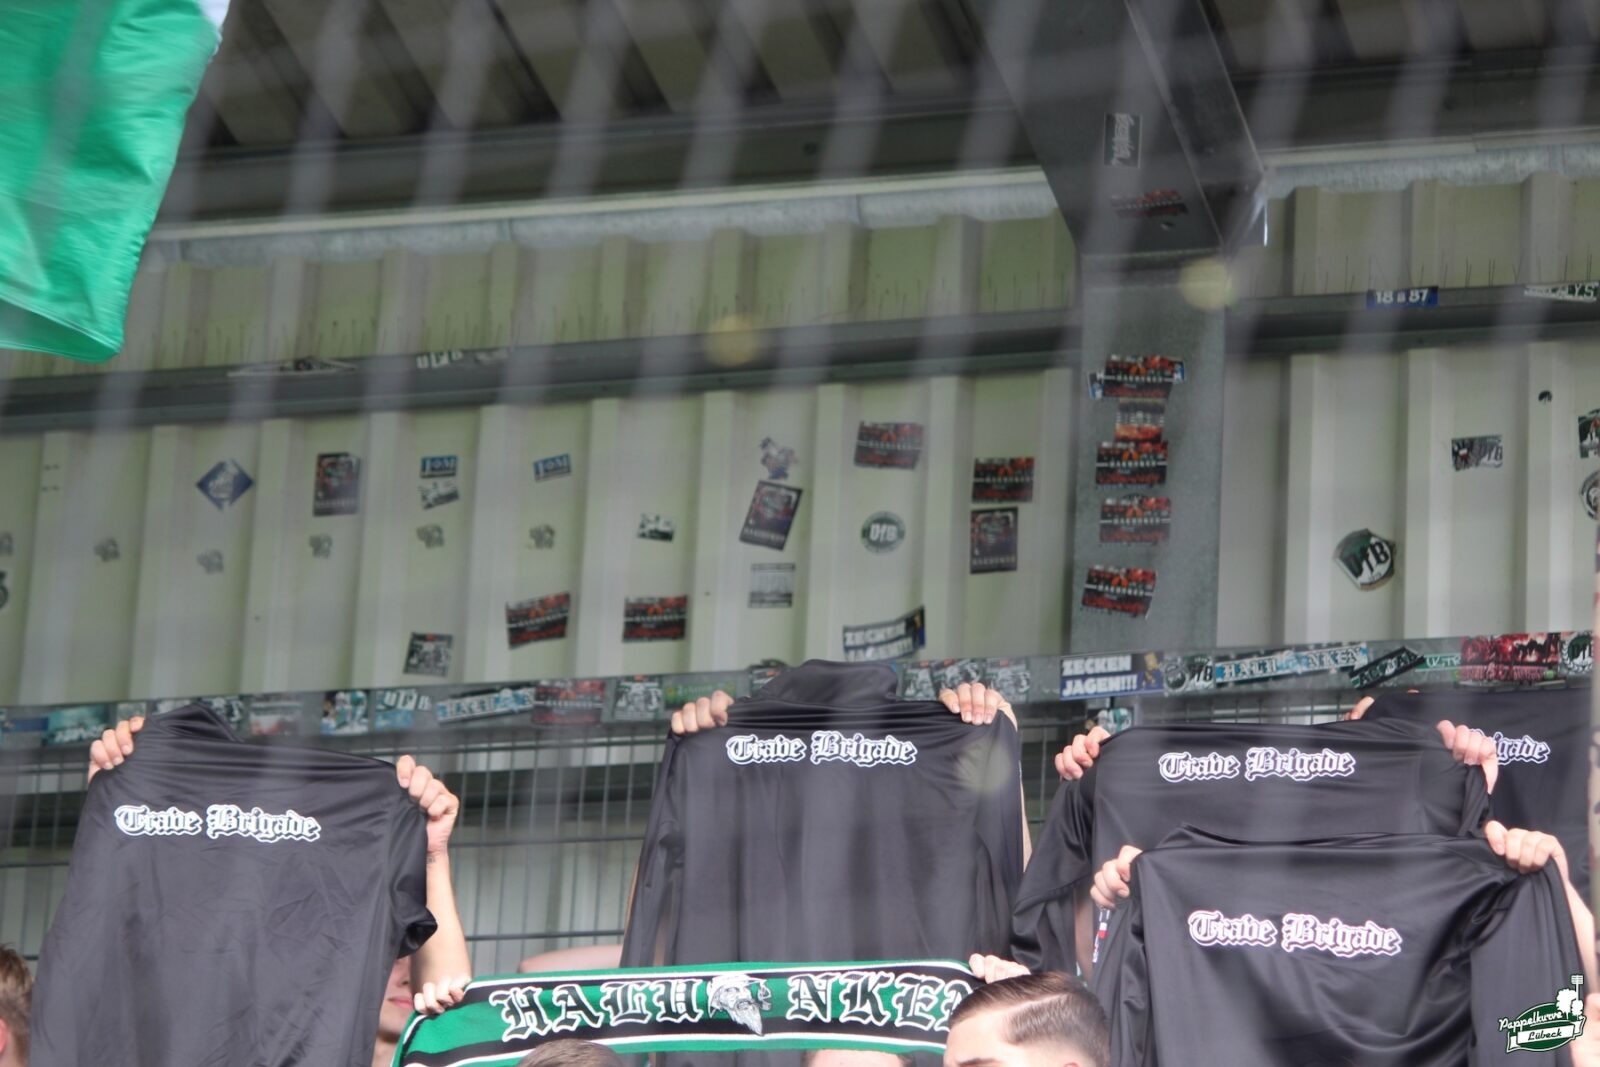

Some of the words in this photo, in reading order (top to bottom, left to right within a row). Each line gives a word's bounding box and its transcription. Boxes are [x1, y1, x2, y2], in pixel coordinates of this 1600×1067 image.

[1062, 655, 1132, 676] ZECKEN
[1062, 675, 1137, 697] JAGEN!!!
[725, 734, 807, 765] Trave
[810, 730, 918, 767] Brigade
[1158, 751, 1241, 783] Trave
[1244, 747, 1356, 781] Brigade
[114, 805, 203, 836] Trave
[206, 804, 322, 843] Brigade
[1188, 910, 1278, 947] Trave
[1281, 912, 1403, 958] Brigade
